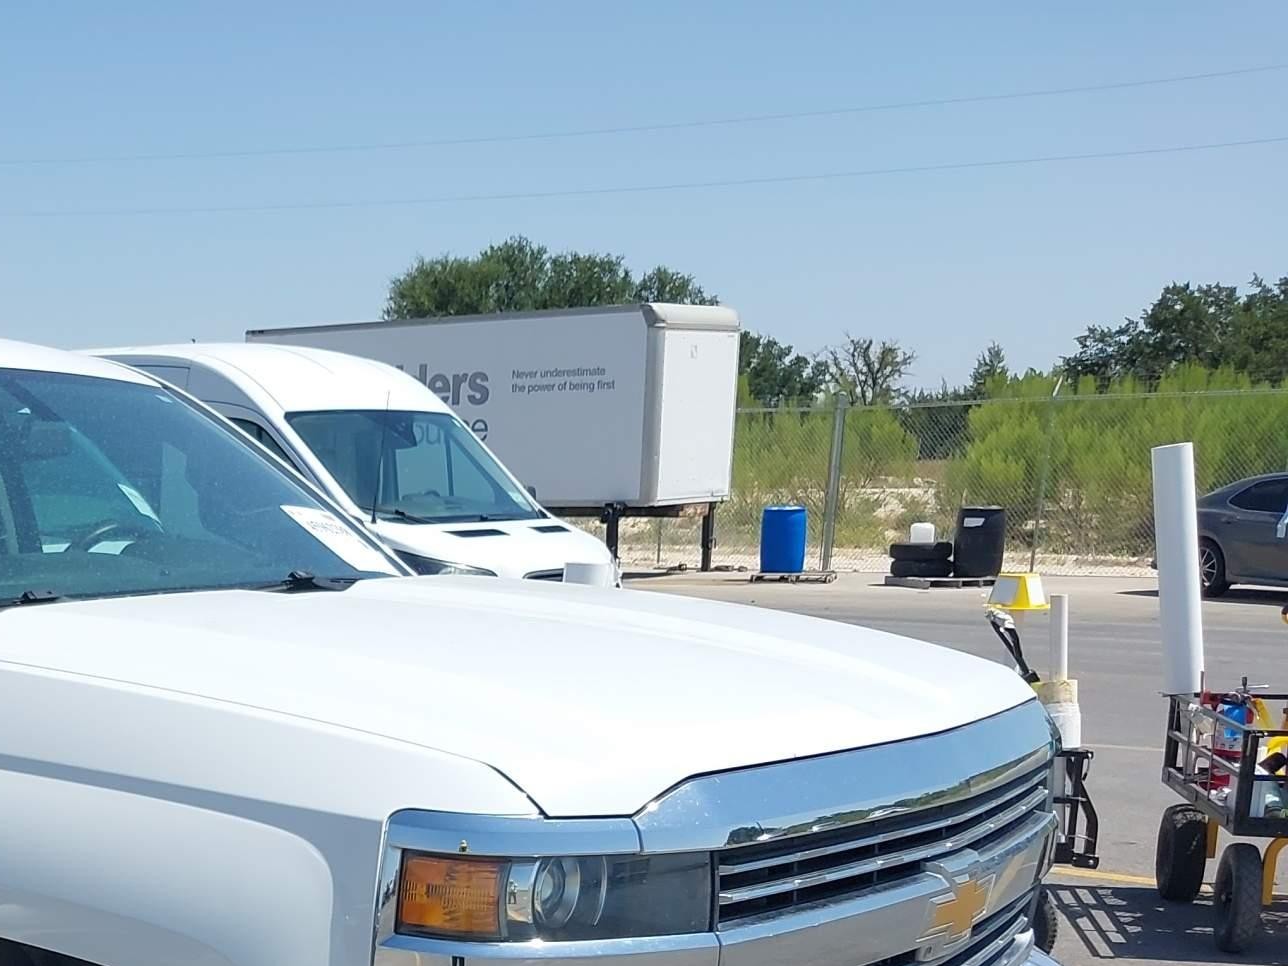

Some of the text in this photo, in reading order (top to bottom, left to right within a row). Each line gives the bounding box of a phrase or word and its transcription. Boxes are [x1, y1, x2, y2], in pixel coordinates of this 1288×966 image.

[512, 366, 606, 379] Never underestimate
[512, 379, 615, 395] the power of being first
